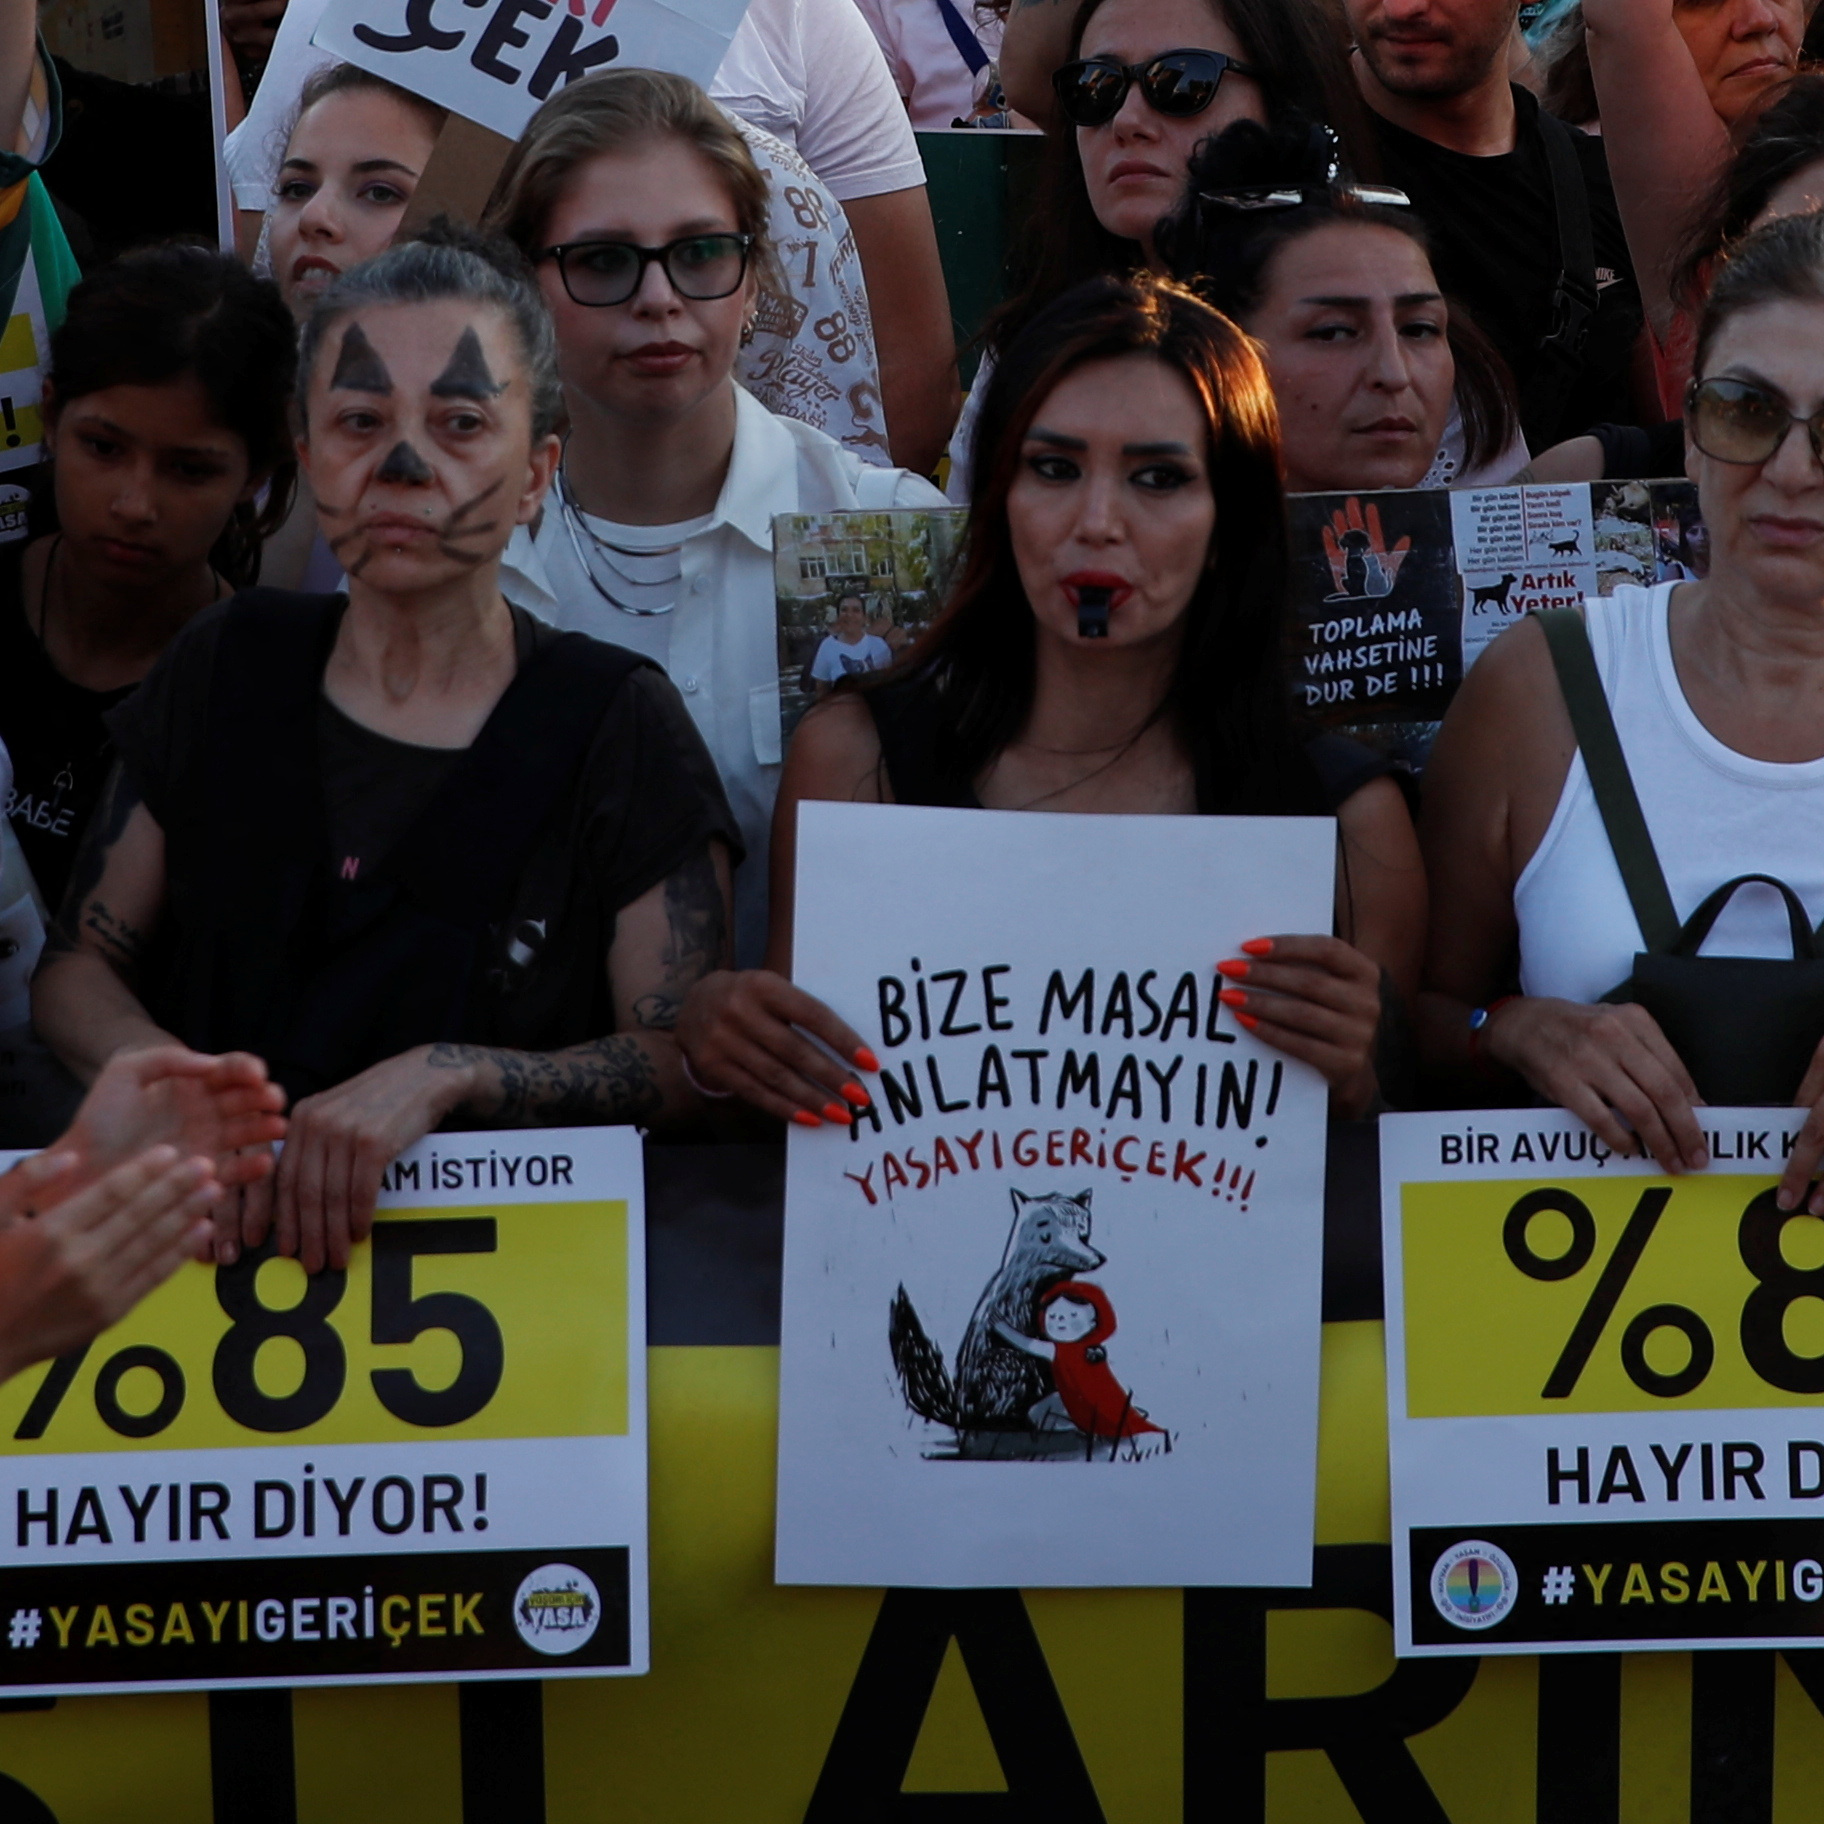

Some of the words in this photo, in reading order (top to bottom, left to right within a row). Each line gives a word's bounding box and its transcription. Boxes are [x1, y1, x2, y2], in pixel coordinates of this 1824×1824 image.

[1521, 569, 1576, 590] Artık
[1510, 590, 1585, 614] Yeter!
[1309, 607, 1424, 645] TOPLAMA
[1303, 633, 1440, 676] VAHSETİNE
[1306, 678, 1356, 708] DUR
[1366, 673, 1398, 697] DE
[1411, 662, 1444, 691] !!!
[877, 955, 1013, 1049] BİZE
[1037, 965, 1237, 1047] MASAL
[846, 1043, 1285, 1149] ANLATMAYIN!
[1438, 1124, 1500, 1166] BİR
[430, 1147, 575, 1190] İSTİYOR
[843, 1126, 1258, 1213] YASAYIGERİÇEK!!!
[1545, 1437, 1766, 1508] HAYIR
[15, 1479, 234, 1550] HAYIR
[253, 1461, 492, 1540] DİYOR!
[7, 1586, 486, 1653] #YASAYIGERİÇEK
[529, 1607, 585, 1629] YASA
